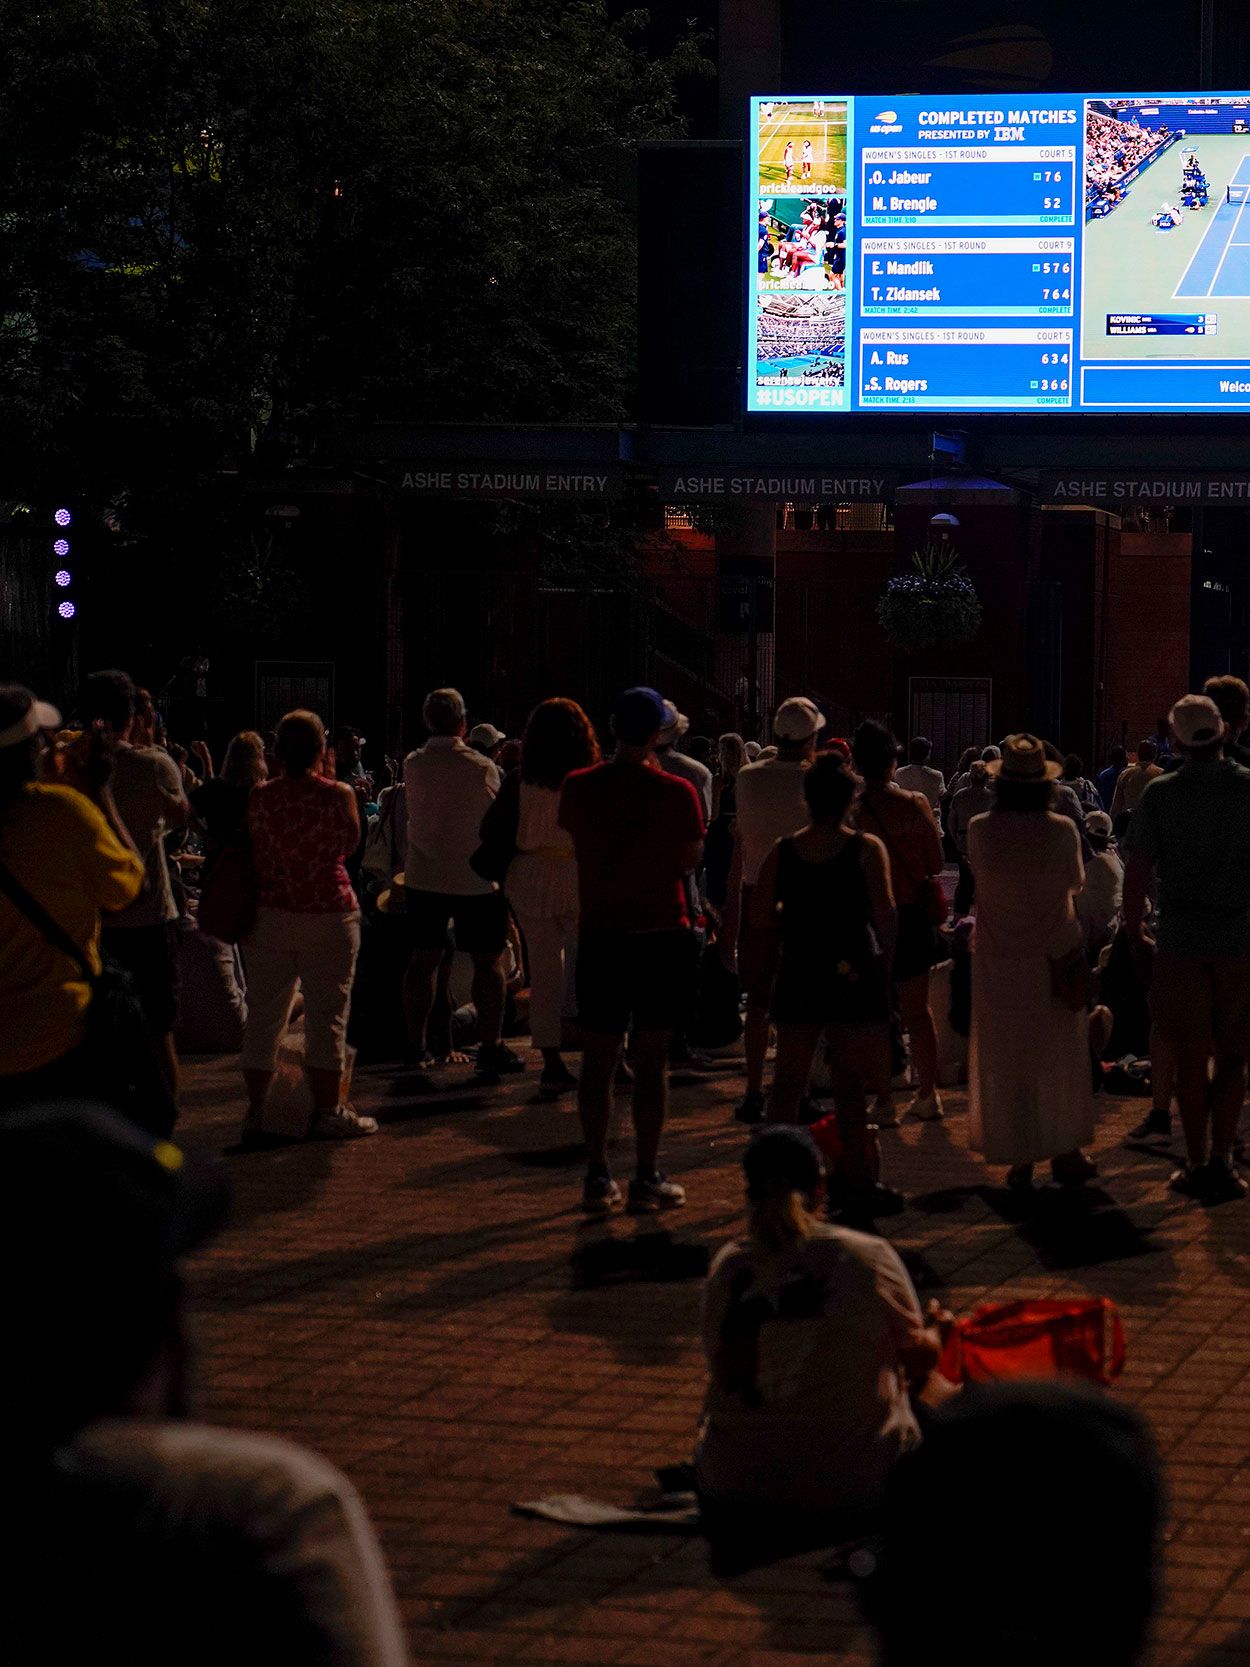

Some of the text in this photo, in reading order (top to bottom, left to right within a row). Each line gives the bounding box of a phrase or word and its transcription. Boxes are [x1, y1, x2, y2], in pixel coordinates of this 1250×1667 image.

[919, 110, 1076, 125] COMPLETED MATCHES
[918, 127, 1025, 141] PRESENTED BY IBM
[865, 150, 987, 159] WOMEN'S SINGLES 1ST ROUND
[888, 170, 931, 185] Jabeur
[872, 197, 937, 213] M. Brengle
[865, 242, 986, 250] WOMEN'S SINGLES 1ST ROUND
[1038, 241, 1072, 249] COURT 9
[872, 261, 883, 275] E.
[872, 287, 940, 301] T. Zidansek
[863, 332, 985, 340] WOMEN'S SINGLES 1ST ROUND
[1037, 332, 1070, 340] COURT 5
[871, 351, 908, 365] A. Rus
[886, 377, 927, 393] Rogers
[756, 389, 843, 406] #USOPEN
[401, 473, 608, 492] ASHE STADIUM ENTRY
[673, 477, 884, 495] ASHE STADIUM ENTRY
[1053, 481, 1107, 498] ASHE
[1113, 481, 1202, 499] STADIUM
